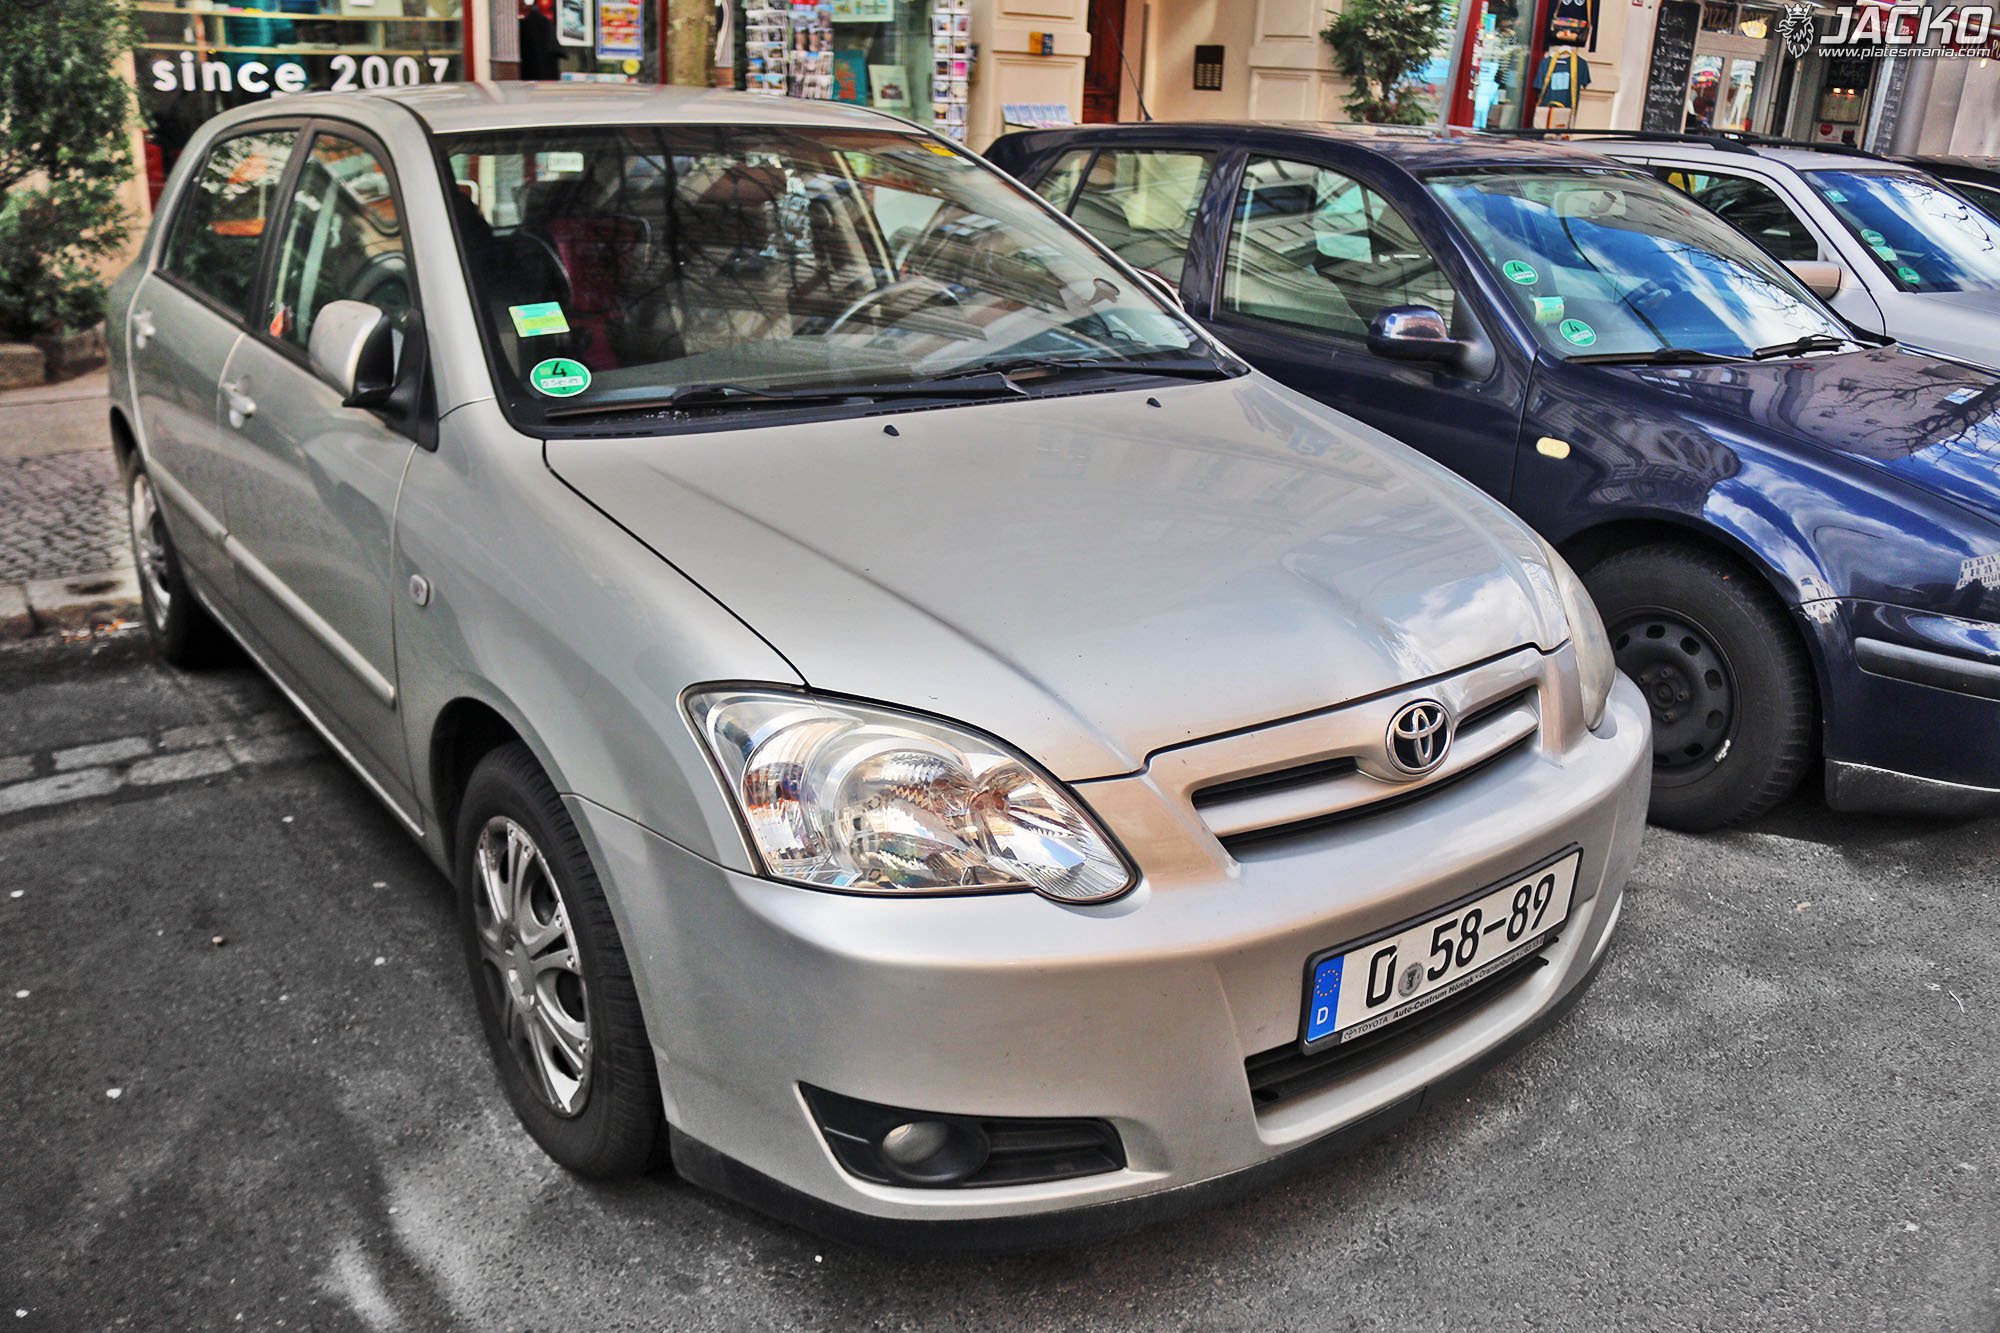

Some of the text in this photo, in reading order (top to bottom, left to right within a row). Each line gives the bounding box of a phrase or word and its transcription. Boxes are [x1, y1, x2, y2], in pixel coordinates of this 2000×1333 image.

[151, 51, 449, 92] since 2007
[552, 361, 567, 378] 4
[1427, 873, 1555, 981] 58-89
[1316, 1006, 1329, 1025] D
[1358, 1016, 1388, 1034] TOYOTA
[1392, 990, 1448, 1020] Auto-Centrum
